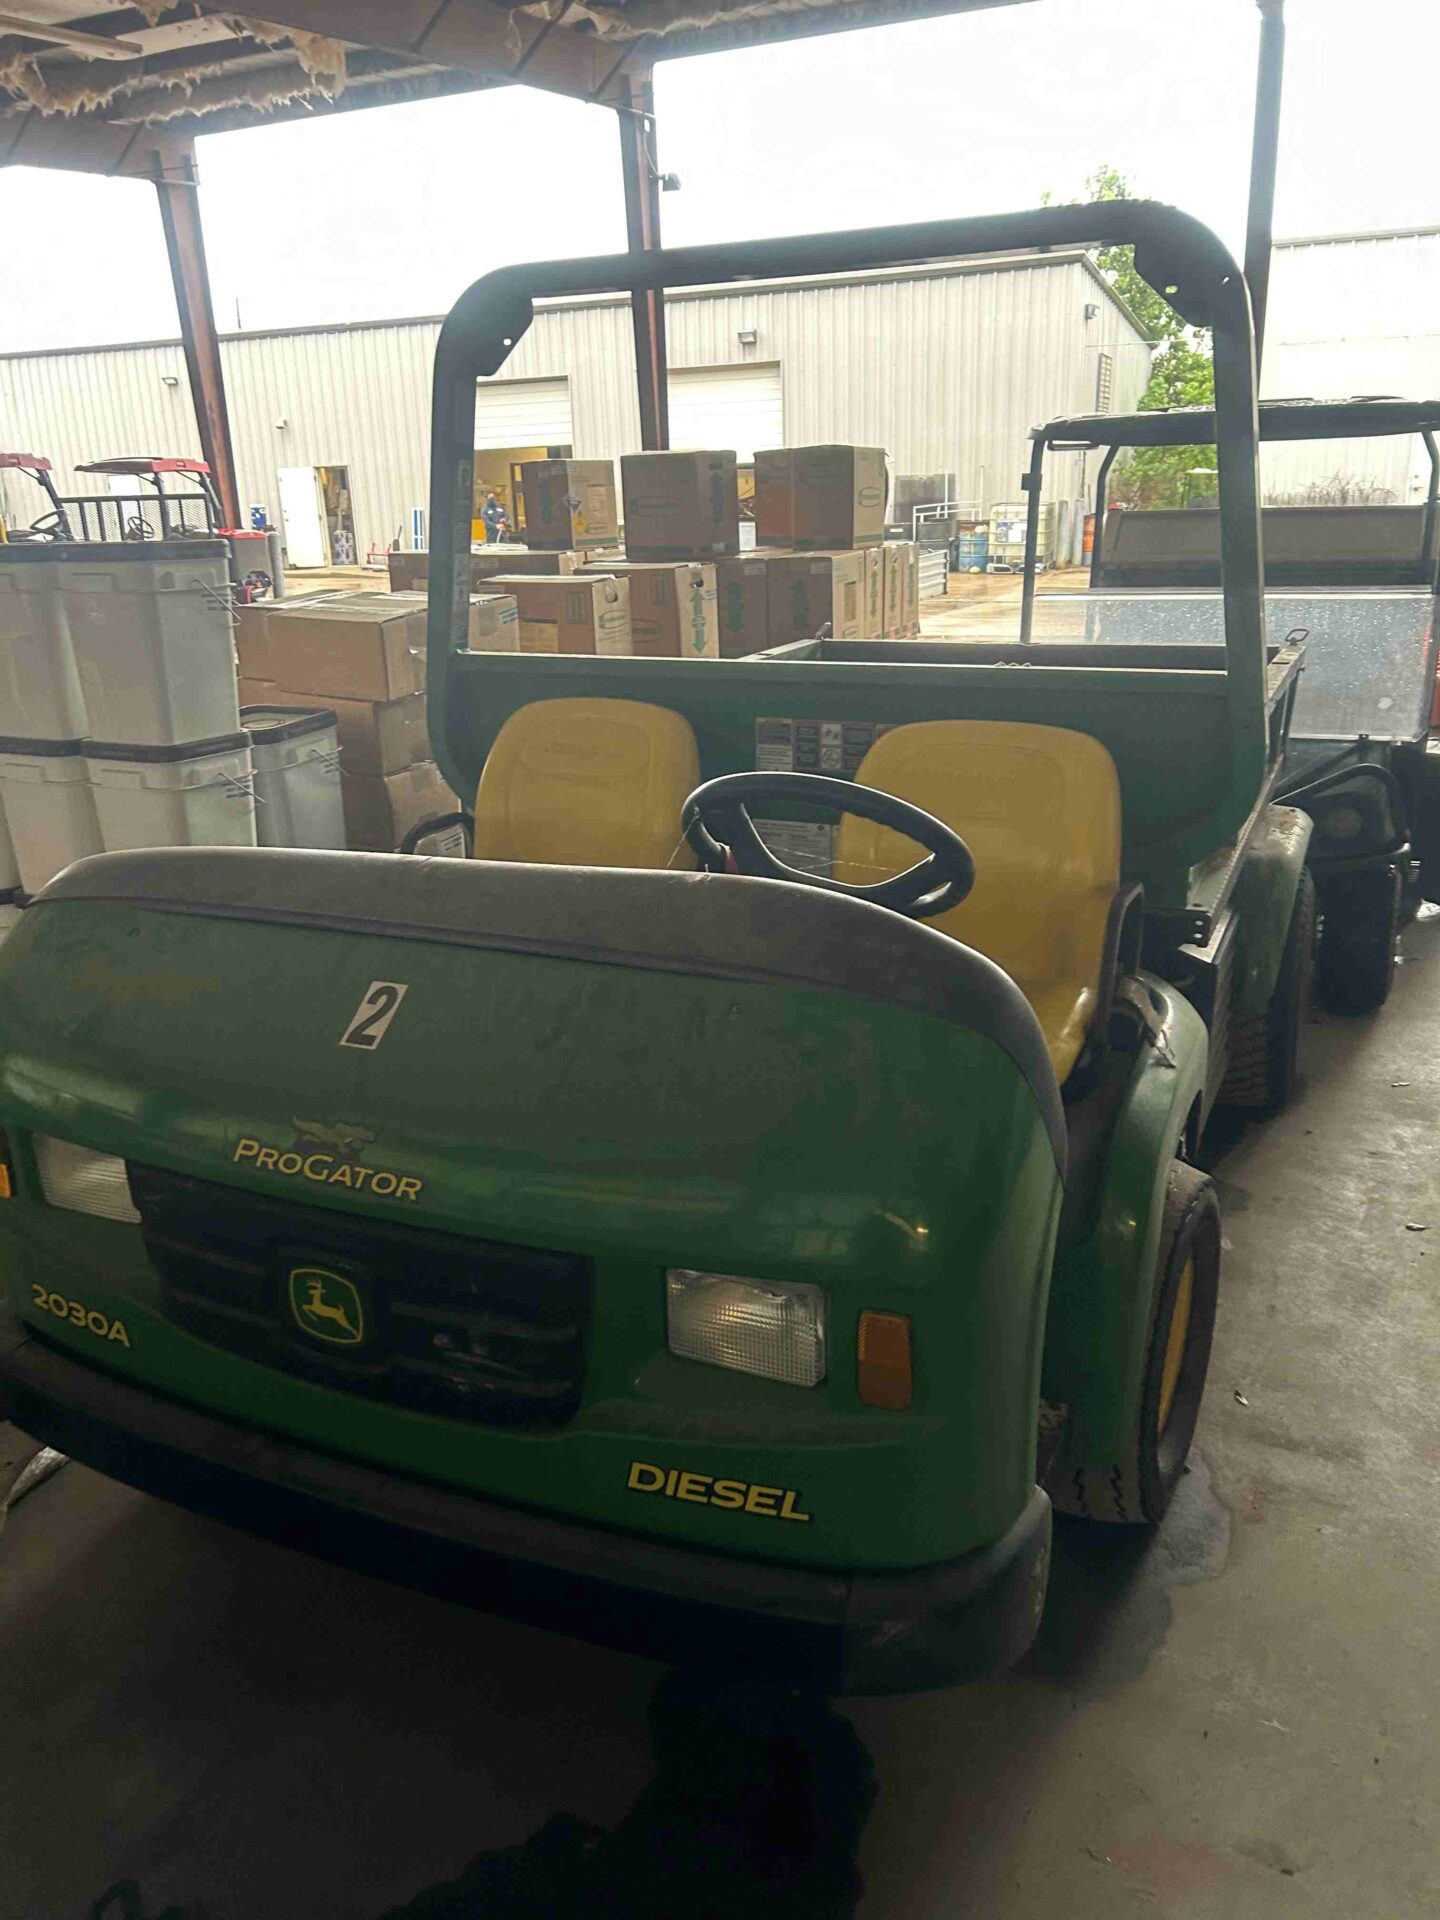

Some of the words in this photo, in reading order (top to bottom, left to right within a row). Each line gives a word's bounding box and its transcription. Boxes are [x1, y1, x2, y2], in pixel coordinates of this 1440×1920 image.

[345, 984, 400, 1047] 2
[233, 1138, 424, 1200] PROGATOR
[31, 1283, 131, 1348] 2030A
[627, 1461, 812, 1522] DIESEL
